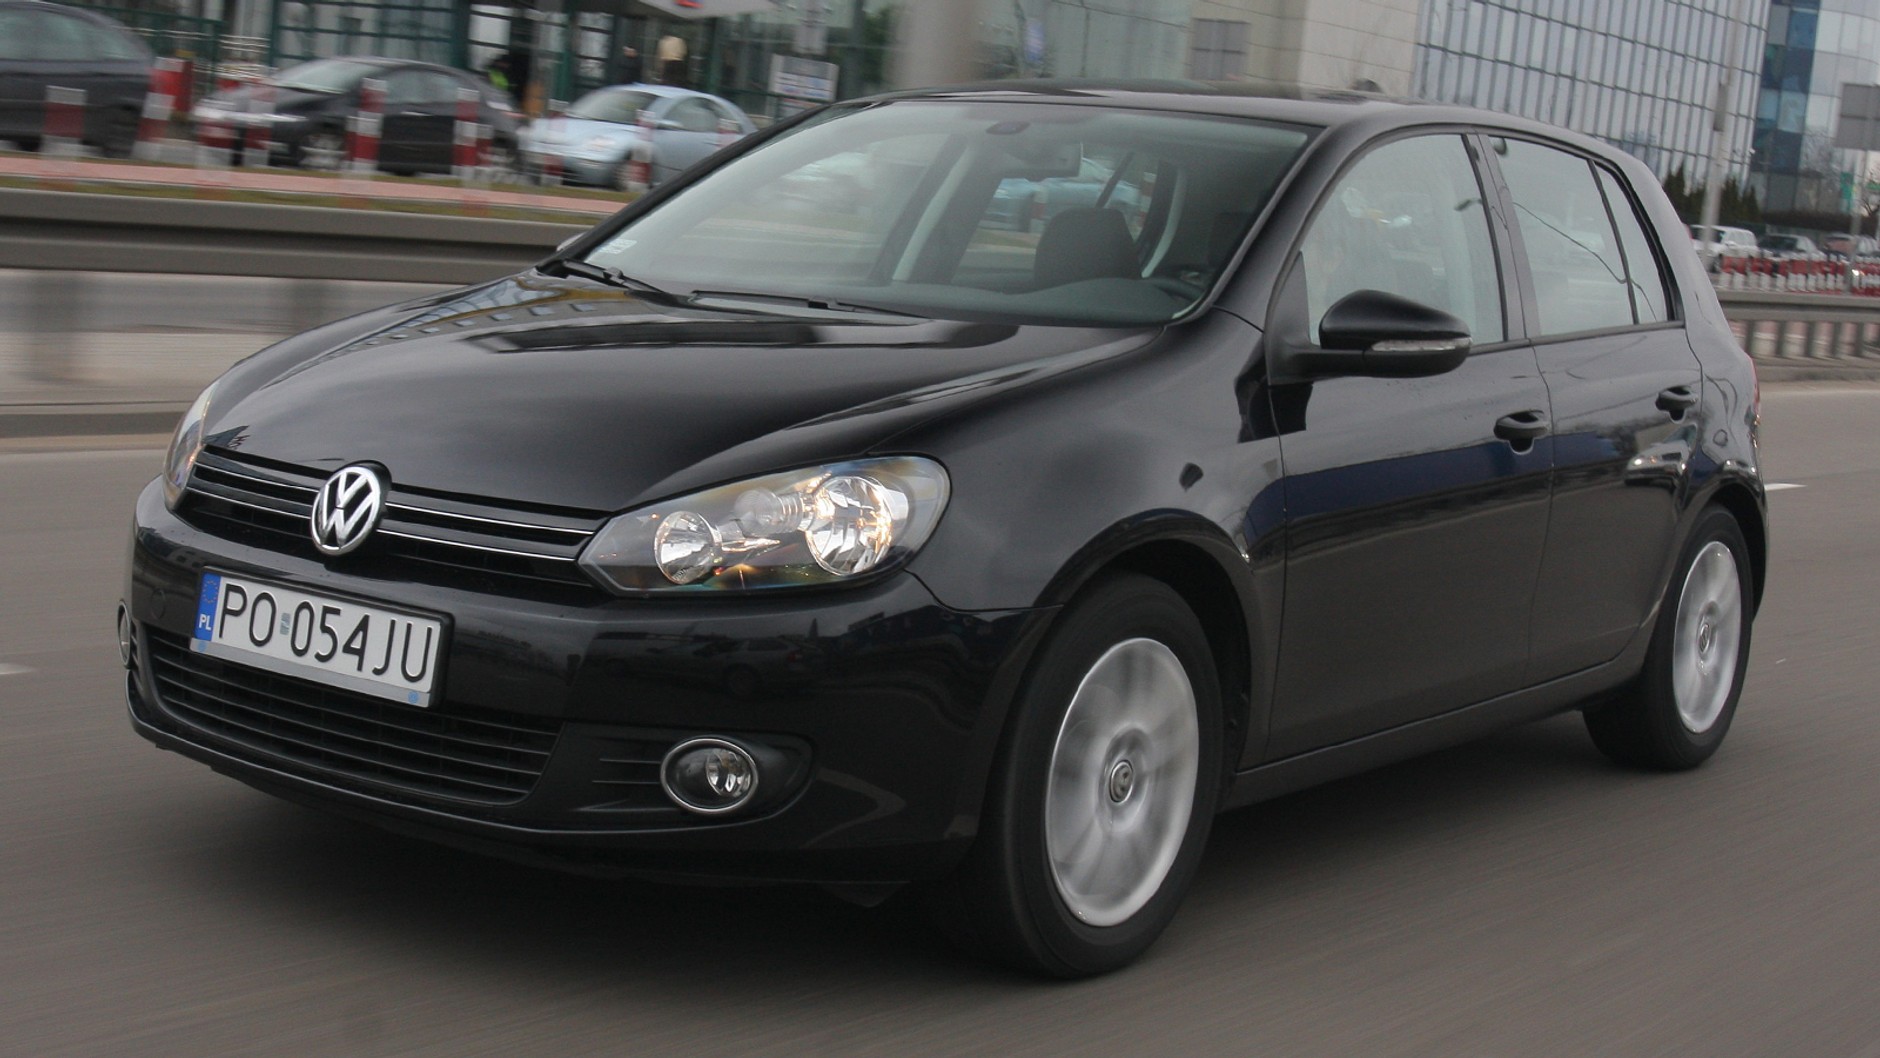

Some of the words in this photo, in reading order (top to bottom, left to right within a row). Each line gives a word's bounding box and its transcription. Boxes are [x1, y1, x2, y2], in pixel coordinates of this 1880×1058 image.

[311, 465, 381, 554] VW
[198, 613, 212, 631] PL
[218, 582, 277, 648] PO
[290, 600, 433, 683] 054JU
